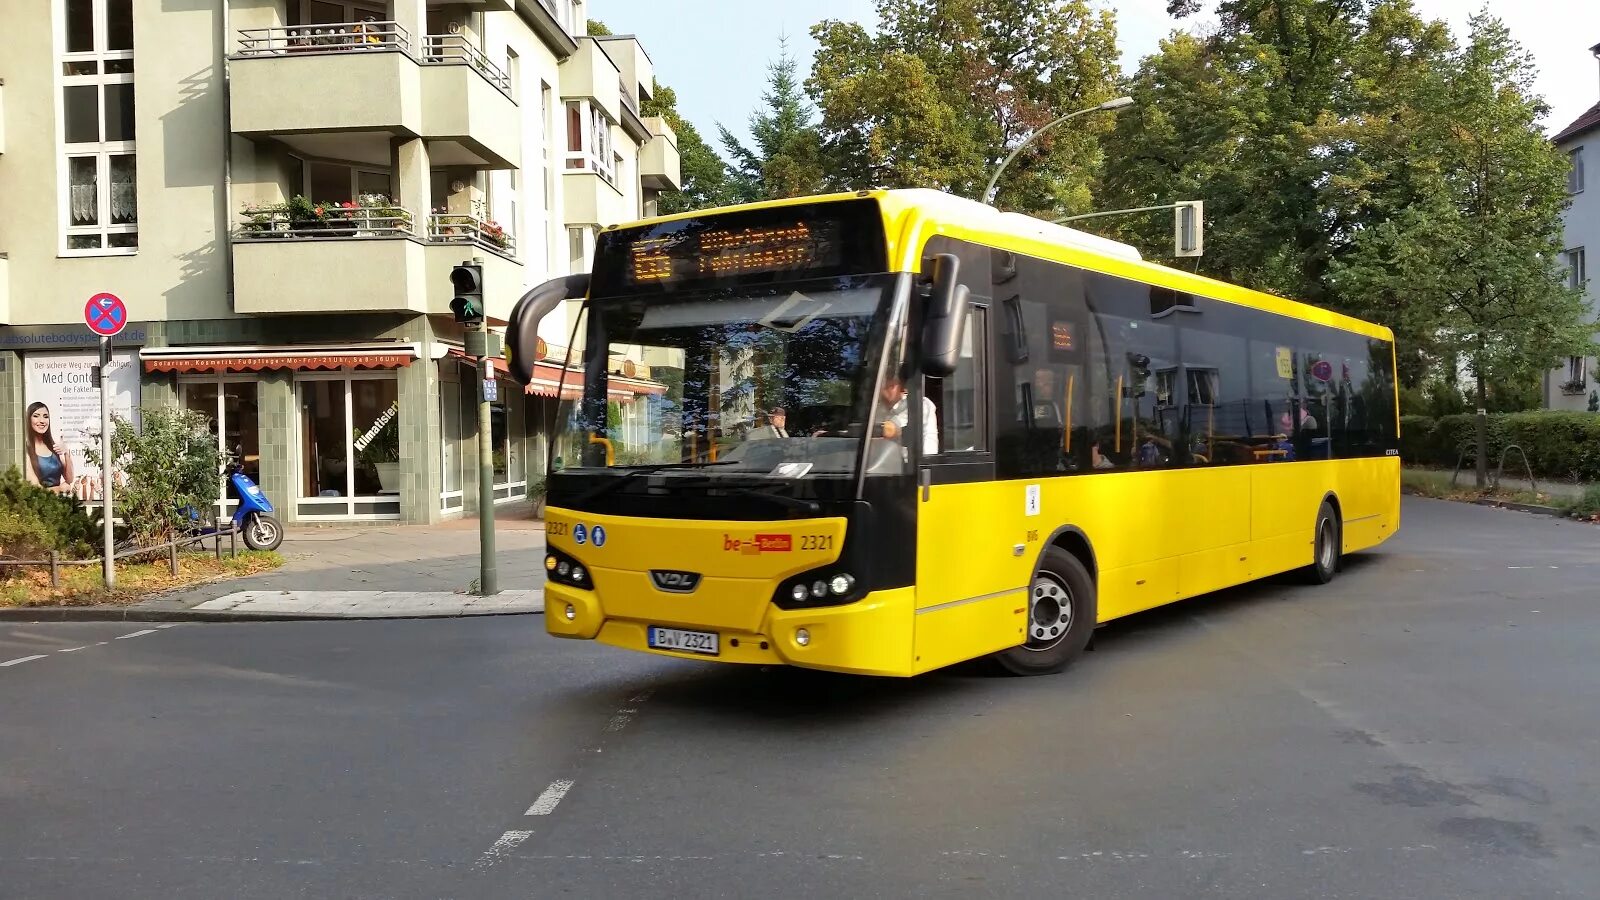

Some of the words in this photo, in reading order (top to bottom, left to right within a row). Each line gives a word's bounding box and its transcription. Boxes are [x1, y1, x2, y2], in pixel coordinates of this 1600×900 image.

[34, 362, 45, 370] Der
[46, 361, 67, 369] sichere
[69, 361, 82, 371] Weg
[42, 371, 64, 384] Med
[62, 385, 72, 394] die
[73, 384, 94, 393] Fakten
[1385, 448, 1399, 456] CITEA
[546, 521, 569, 536] 2321
[801, 534, 833, 551] 2321
[655, 572, 694, 587] VDL
[684, 632, 714, 650] 2321
